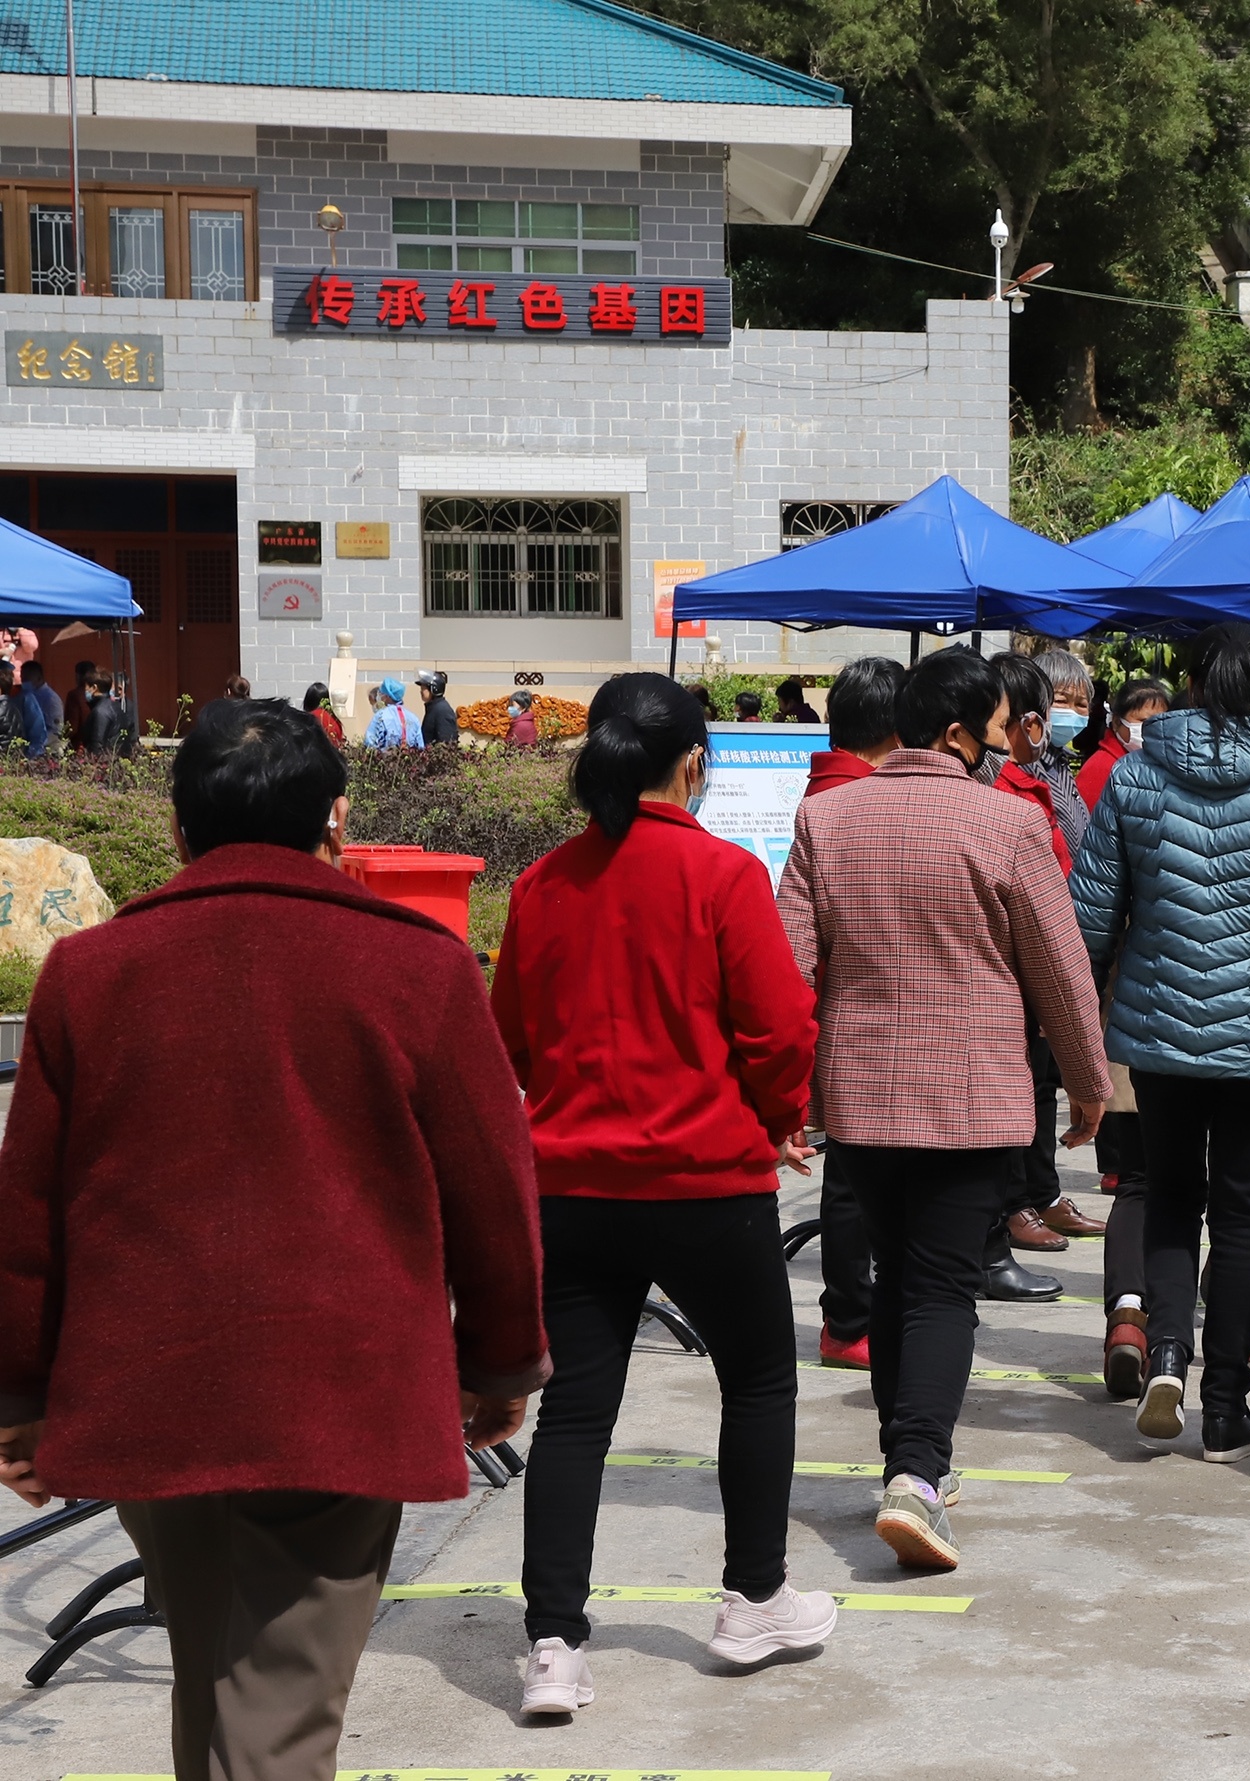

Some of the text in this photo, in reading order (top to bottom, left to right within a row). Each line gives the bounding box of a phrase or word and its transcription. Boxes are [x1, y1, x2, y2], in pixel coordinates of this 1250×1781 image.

[305, 275, 705, 334] 传承红色基因
